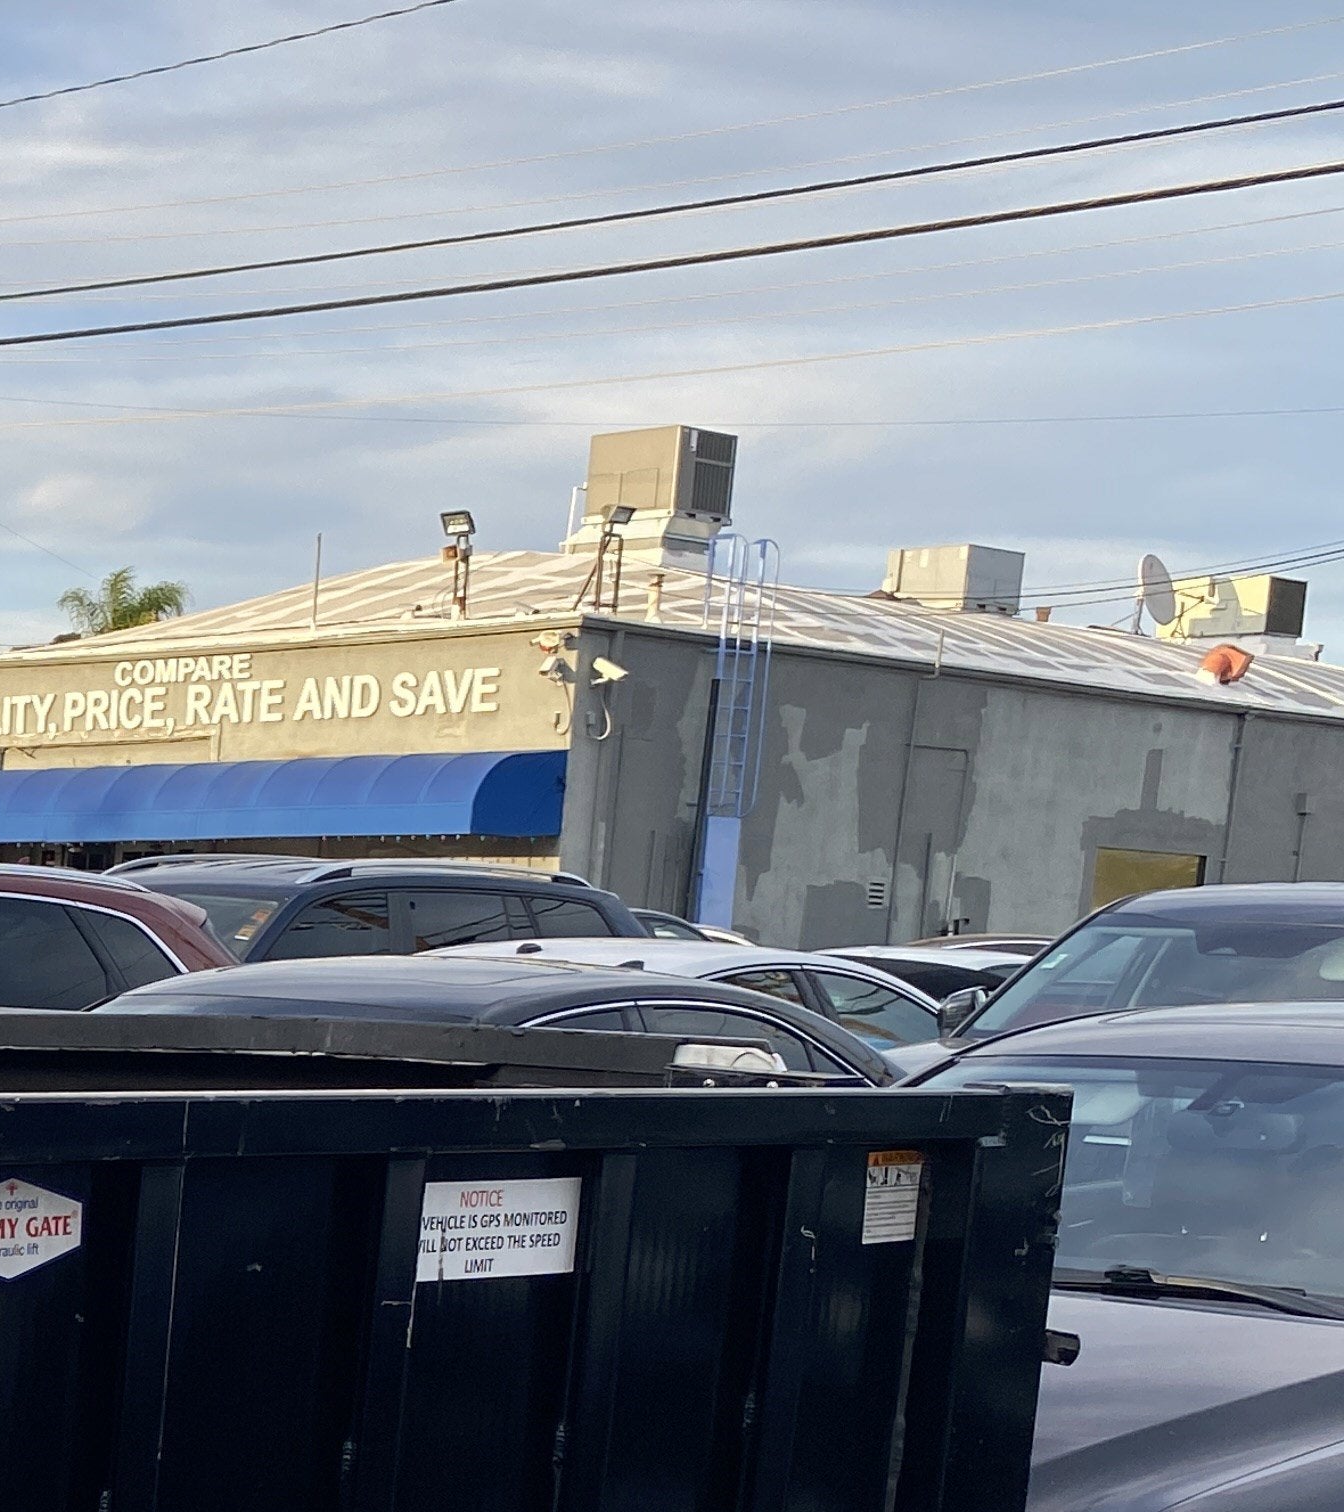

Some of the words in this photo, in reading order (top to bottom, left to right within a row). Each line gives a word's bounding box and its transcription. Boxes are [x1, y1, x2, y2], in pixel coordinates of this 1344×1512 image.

[114, 654, 252, 687] COMPARE
[63, 686, 175, 736] PRICE,
[185, 679, 286, 726] RATE
[292, 674, 382, 721] AND
[388, 667, 501, 718] SAVE
[4, 1196, 39, 1213] original
[459, 1189, 505, 1208] NOTICE
[25, 1215, 73, 1238] GATE
[421, 1214, 466, 1231] VEHICLE
[467, 1214, 478, 1229] IS
[480, 1213, 501, 1228] GPS
[503, 1210, 568, 1227] MONITORED
[26, 1243, 40, 1256] lift
[440, 1235, 463, 1252] NOT
[465, 1235, 504, 1251] EXCEED
[507, 1234, 528, 1250] THE
[528, 1232, 561, 1248] SPEED
[464, 1258, 495, 1274] LIMIT
